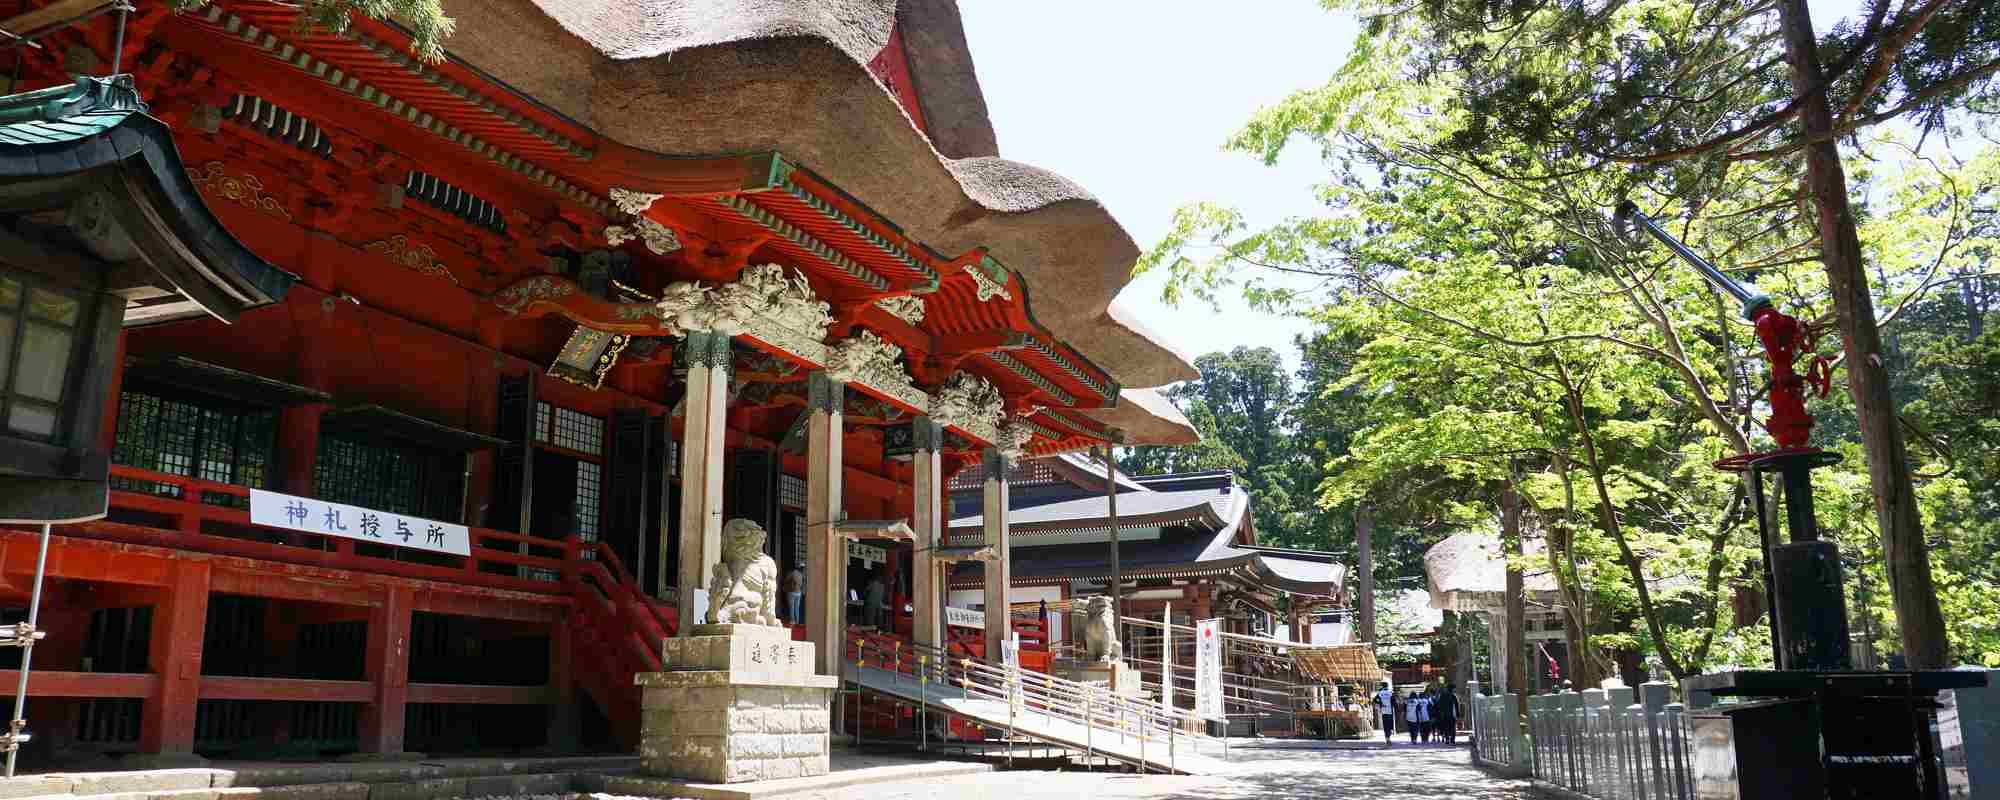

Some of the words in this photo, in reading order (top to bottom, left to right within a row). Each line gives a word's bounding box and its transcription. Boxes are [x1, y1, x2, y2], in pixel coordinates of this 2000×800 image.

[285, 500, 445, 548] 神札授与所
